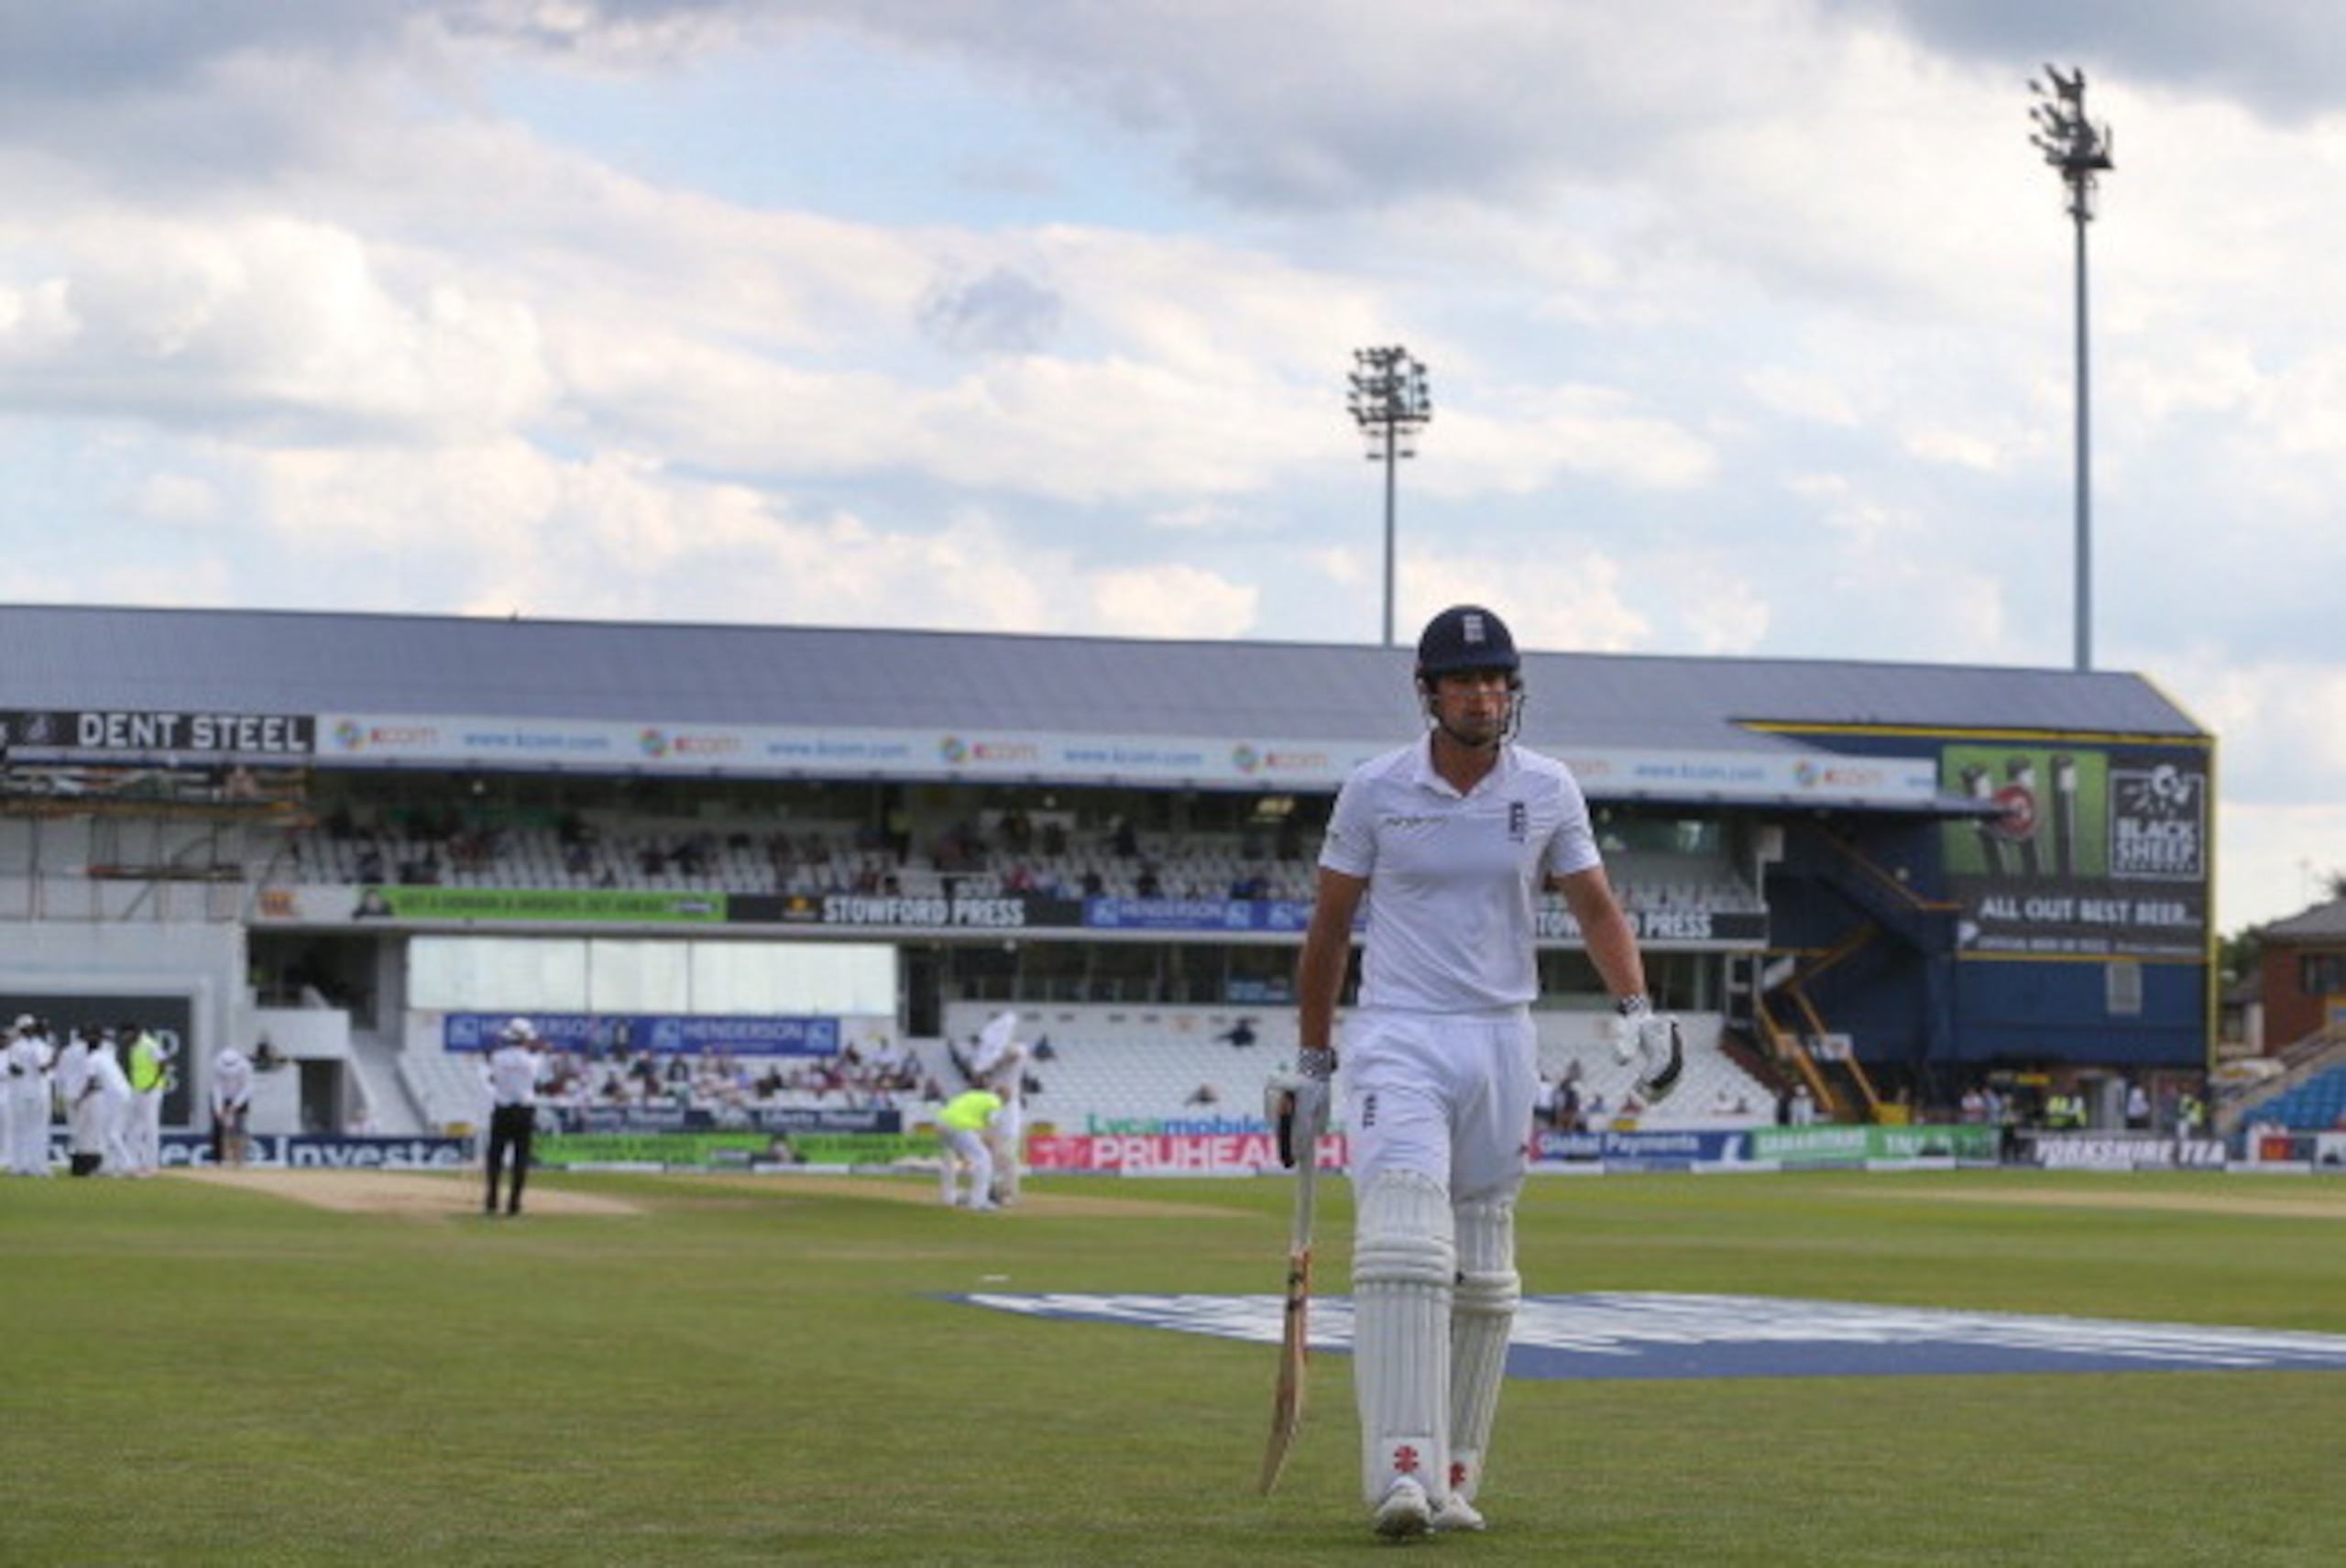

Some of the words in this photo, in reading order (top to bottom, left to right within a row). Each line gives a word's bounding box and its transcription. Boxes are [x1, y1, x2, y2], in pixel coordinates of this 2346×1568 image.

[77, 713, 178, 748] DENT
[192, 717, 306, 751] STEEL
[2117, 818, 2195, 839] BLACK
[2117, 840, 2195, 862] SHEEP
[824, 896, 948, 924] STOWFORD
[951, 899, 1025, 927] PRESS
[1980, 898, 2019, 918] ALL
[2024, 898, 2075, 919] OUT
[2079, 900, 2129, 922] BEST
[1646, 911, 1712, 938] PRESS
[682, 1017, 804, 1039] HENDERSON
[2035, 1140, 2175, 1164] YORKSHIRE
[2178, 1140, 2226, 1163] TEA
